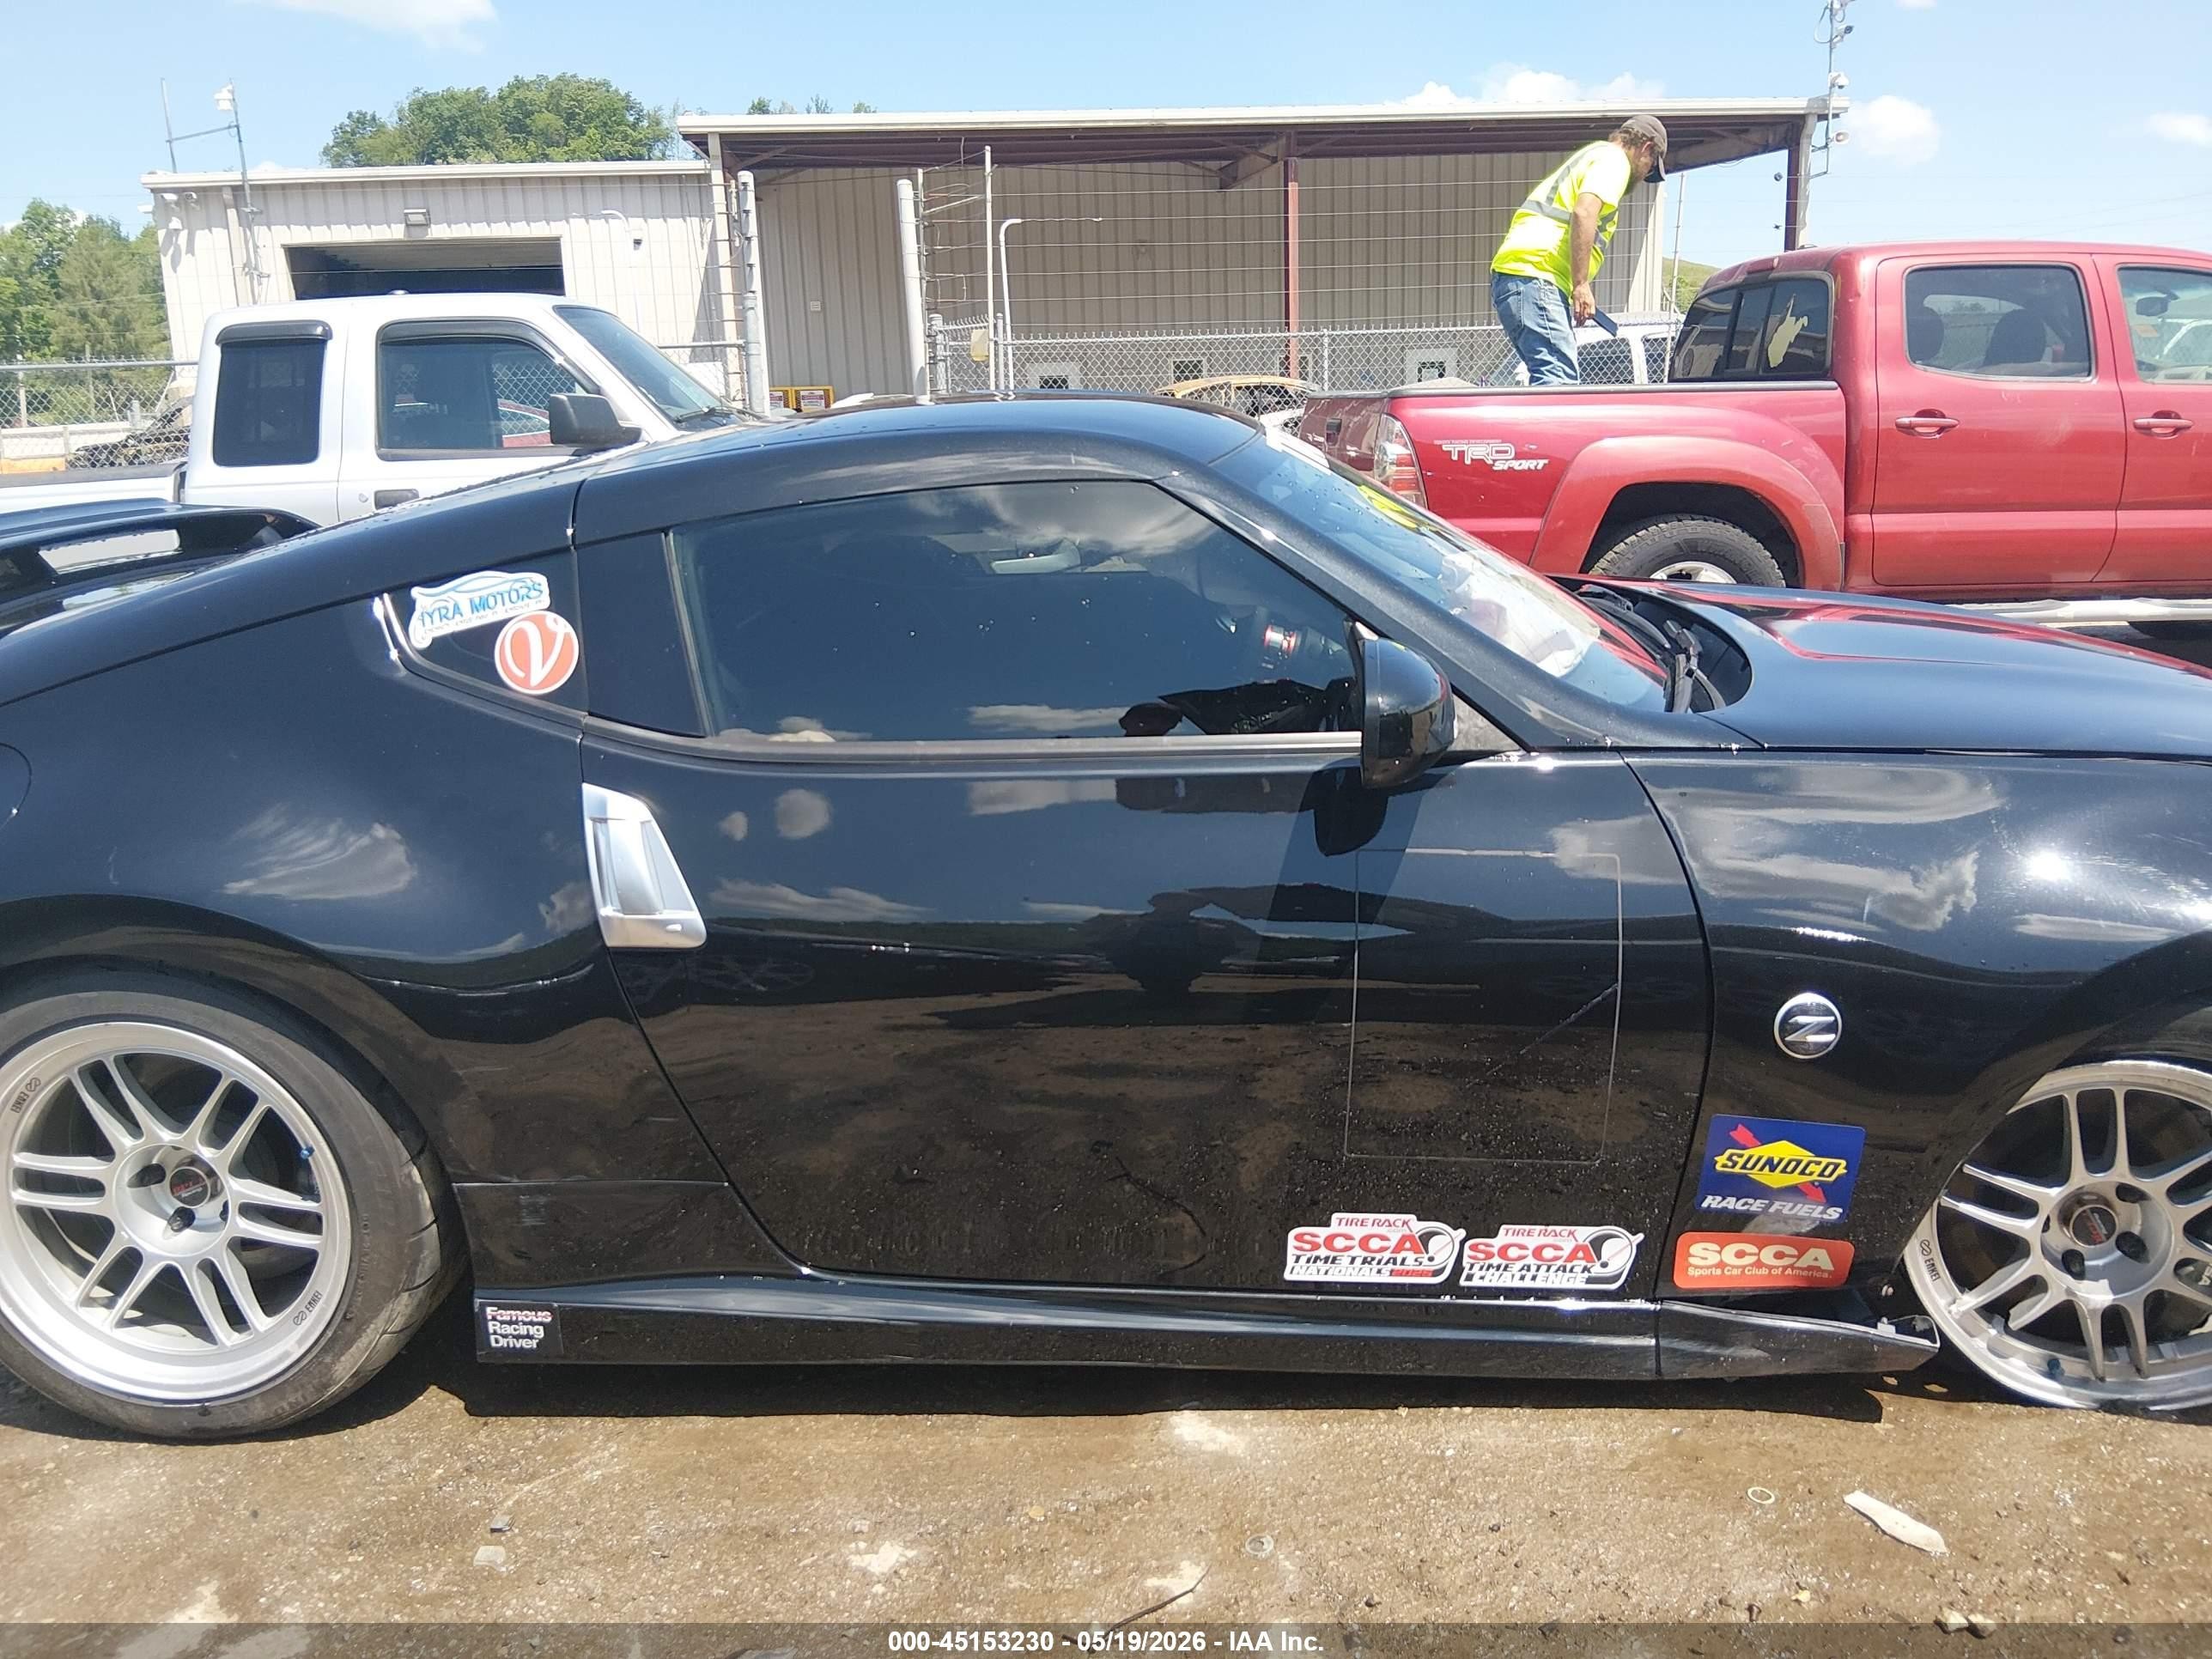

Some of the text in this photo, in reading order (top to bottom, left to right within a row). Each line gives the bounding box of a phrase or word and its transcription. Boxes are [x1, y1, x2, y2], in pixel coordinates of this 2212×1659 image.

[1442, 443, 1515, 465] TRD
[1492, 459, 1549, 471] SPORT
[469, 581, 544, 614] MOTORS
[1784, 1015, 1837, 1042] Z
[1722, 1152, 1842, 1178] SUNOCO
[1701, 1195, 1844, 1220] RACE FUELS
[1335, 1217, 1413, 1230] TIRE RACK
[1293, 1231, 1425, 1255] SCCA
[1504, 1228, 1579, 1241] TIRE RACK
[1292, 1255, 1424, 1267] TIME TRIALS
[1468, 1243, 1598, 1263] SCCA
[1688, 1242, 1835, 1271] SCCA
[1291, 1266, 1391, 1277] NATIONALS
[1467, 1262, 1595, 1274] TIME ATTACK
[1687, 1267, 1722, 1277] Sports
[1723, 1267, 1742, 1275] Car
[1745, 1267, 1768, 1275] Club
[1924, 1257, 1941, 1282] ENKEI
[1473, 1272, 1586, 1285] CHALLENGE
[305, 1290, 323, 1312] ENKEI
[486, 1306, 552, 1322] Famous
[488, 1321, 544, 1339] Racing
[490, 1334, 539, 1348] Driver
